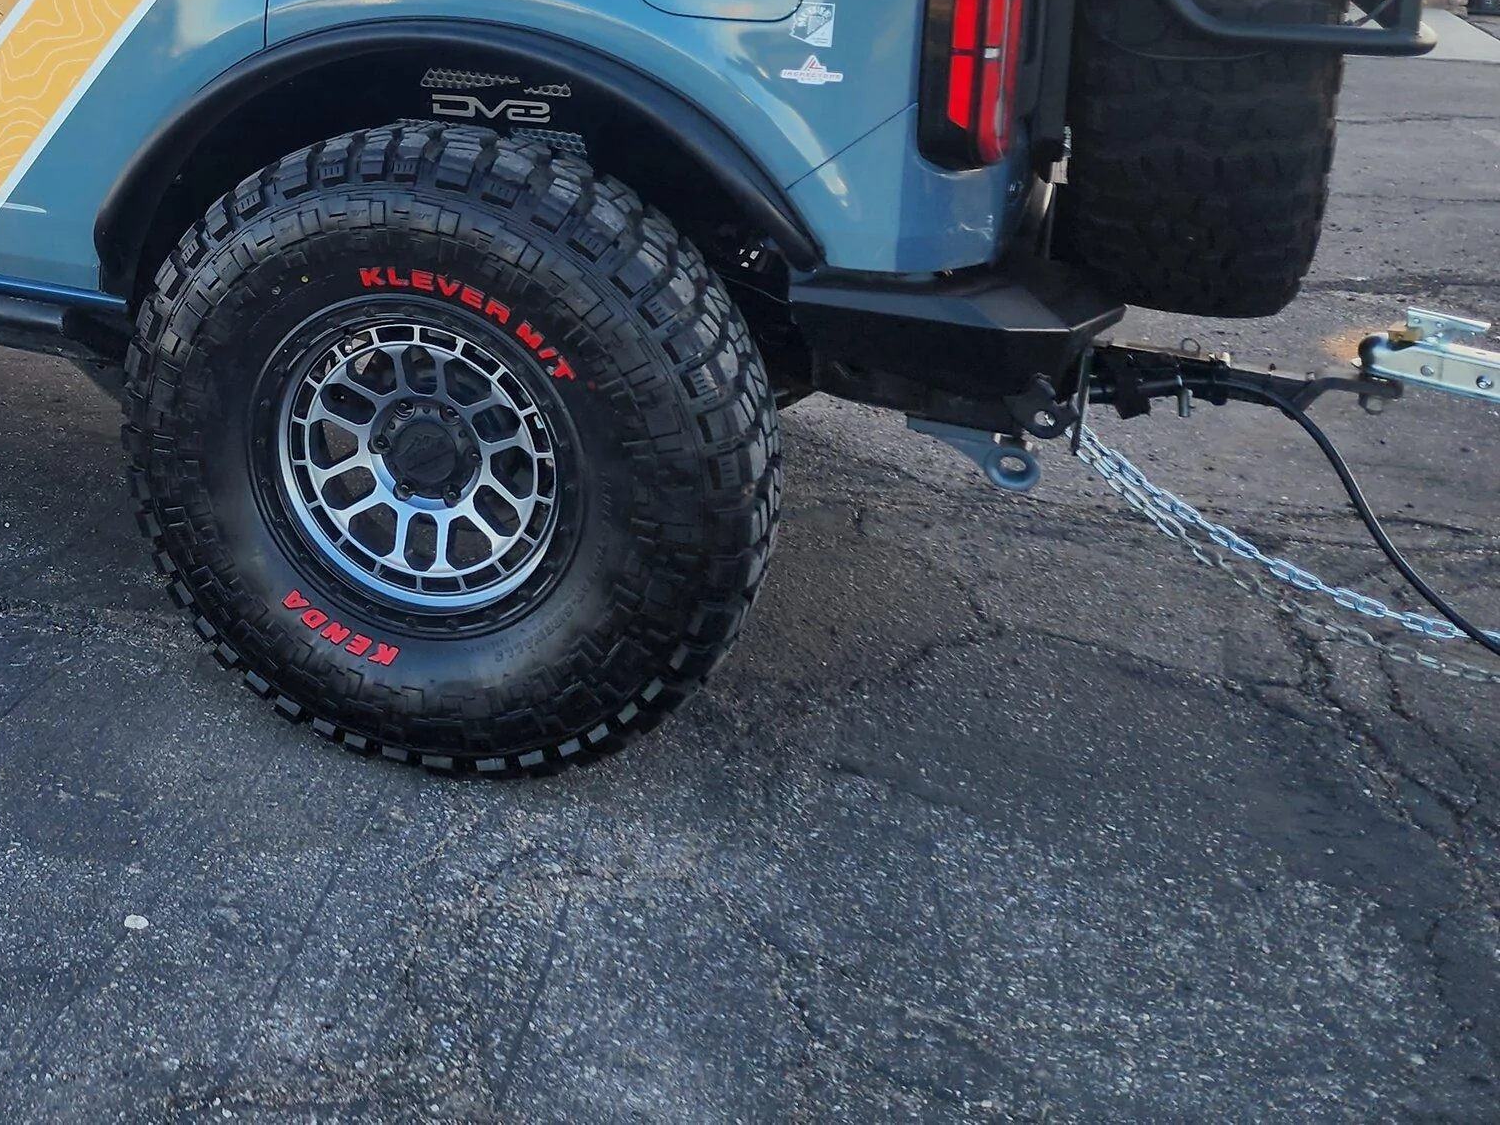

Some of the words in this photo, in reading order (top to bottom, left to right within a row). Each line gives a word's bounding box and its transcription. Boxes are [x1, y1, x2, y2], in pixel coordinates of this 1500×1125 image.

[359, 266, 512, 325] KLEVER
[515, 321, 576, 381] M/T
[281, 588, 400, 667] KENDA
